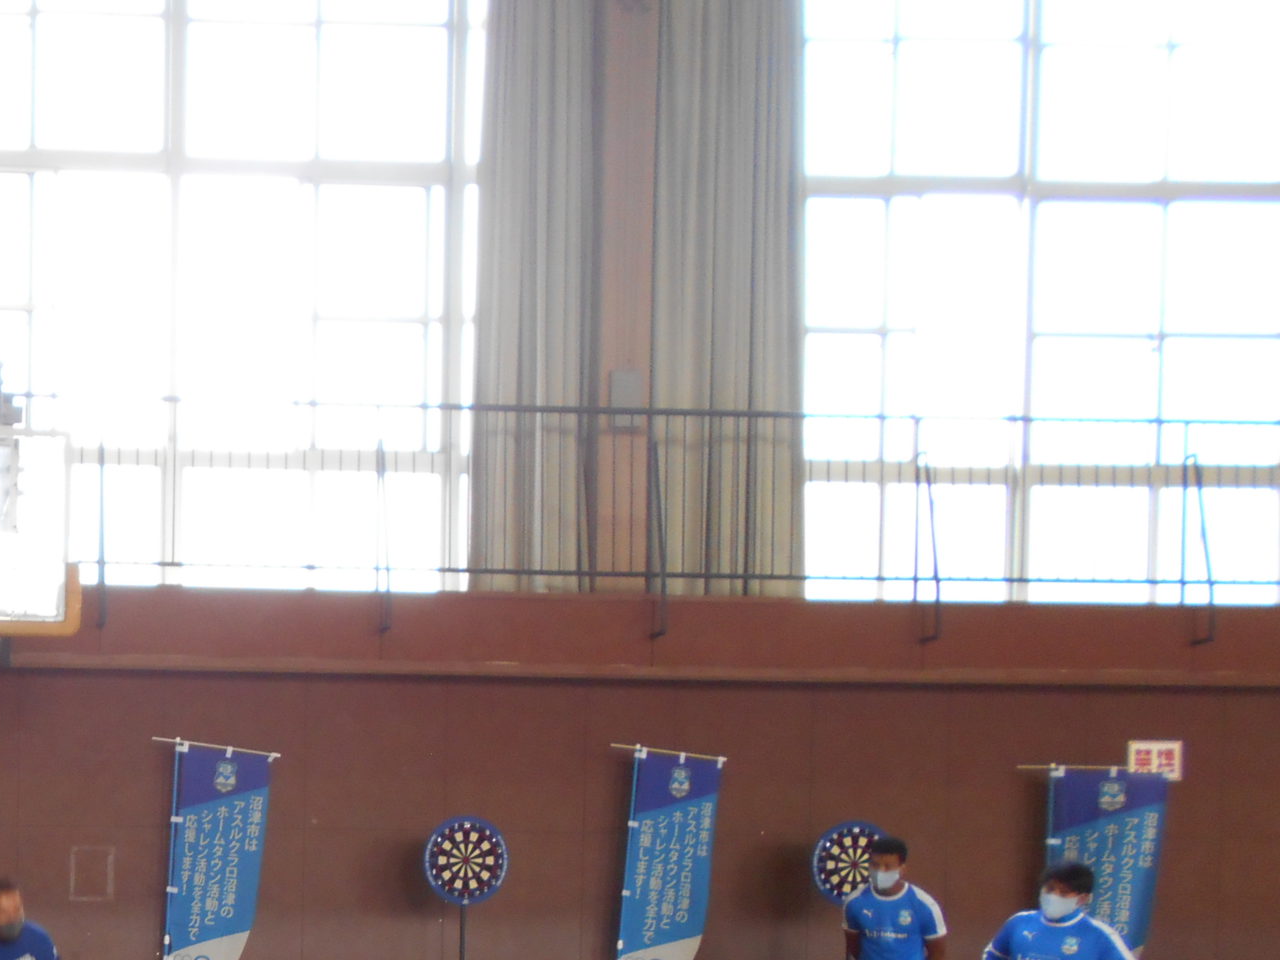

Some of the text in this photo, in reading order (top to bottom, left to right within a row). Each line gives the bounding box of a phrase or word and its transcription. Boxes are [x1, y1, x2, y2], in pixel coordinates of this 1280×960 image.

[181, 815, 198, 895] 応援します!
[204, 806, 230, 926] ホームタウン活動と
[220, 801, 245, 919] アスルクラロ沼津の
[244, 795, 264, 852] 沼津市は
[635, 820, 654, 899] 応援します!
[660, 811, 683, 929] ホームタウン活動と
[675, 806, 698, 923] アスルクラロ沼津の
[697, 802, 713, 857] 沼津市は
